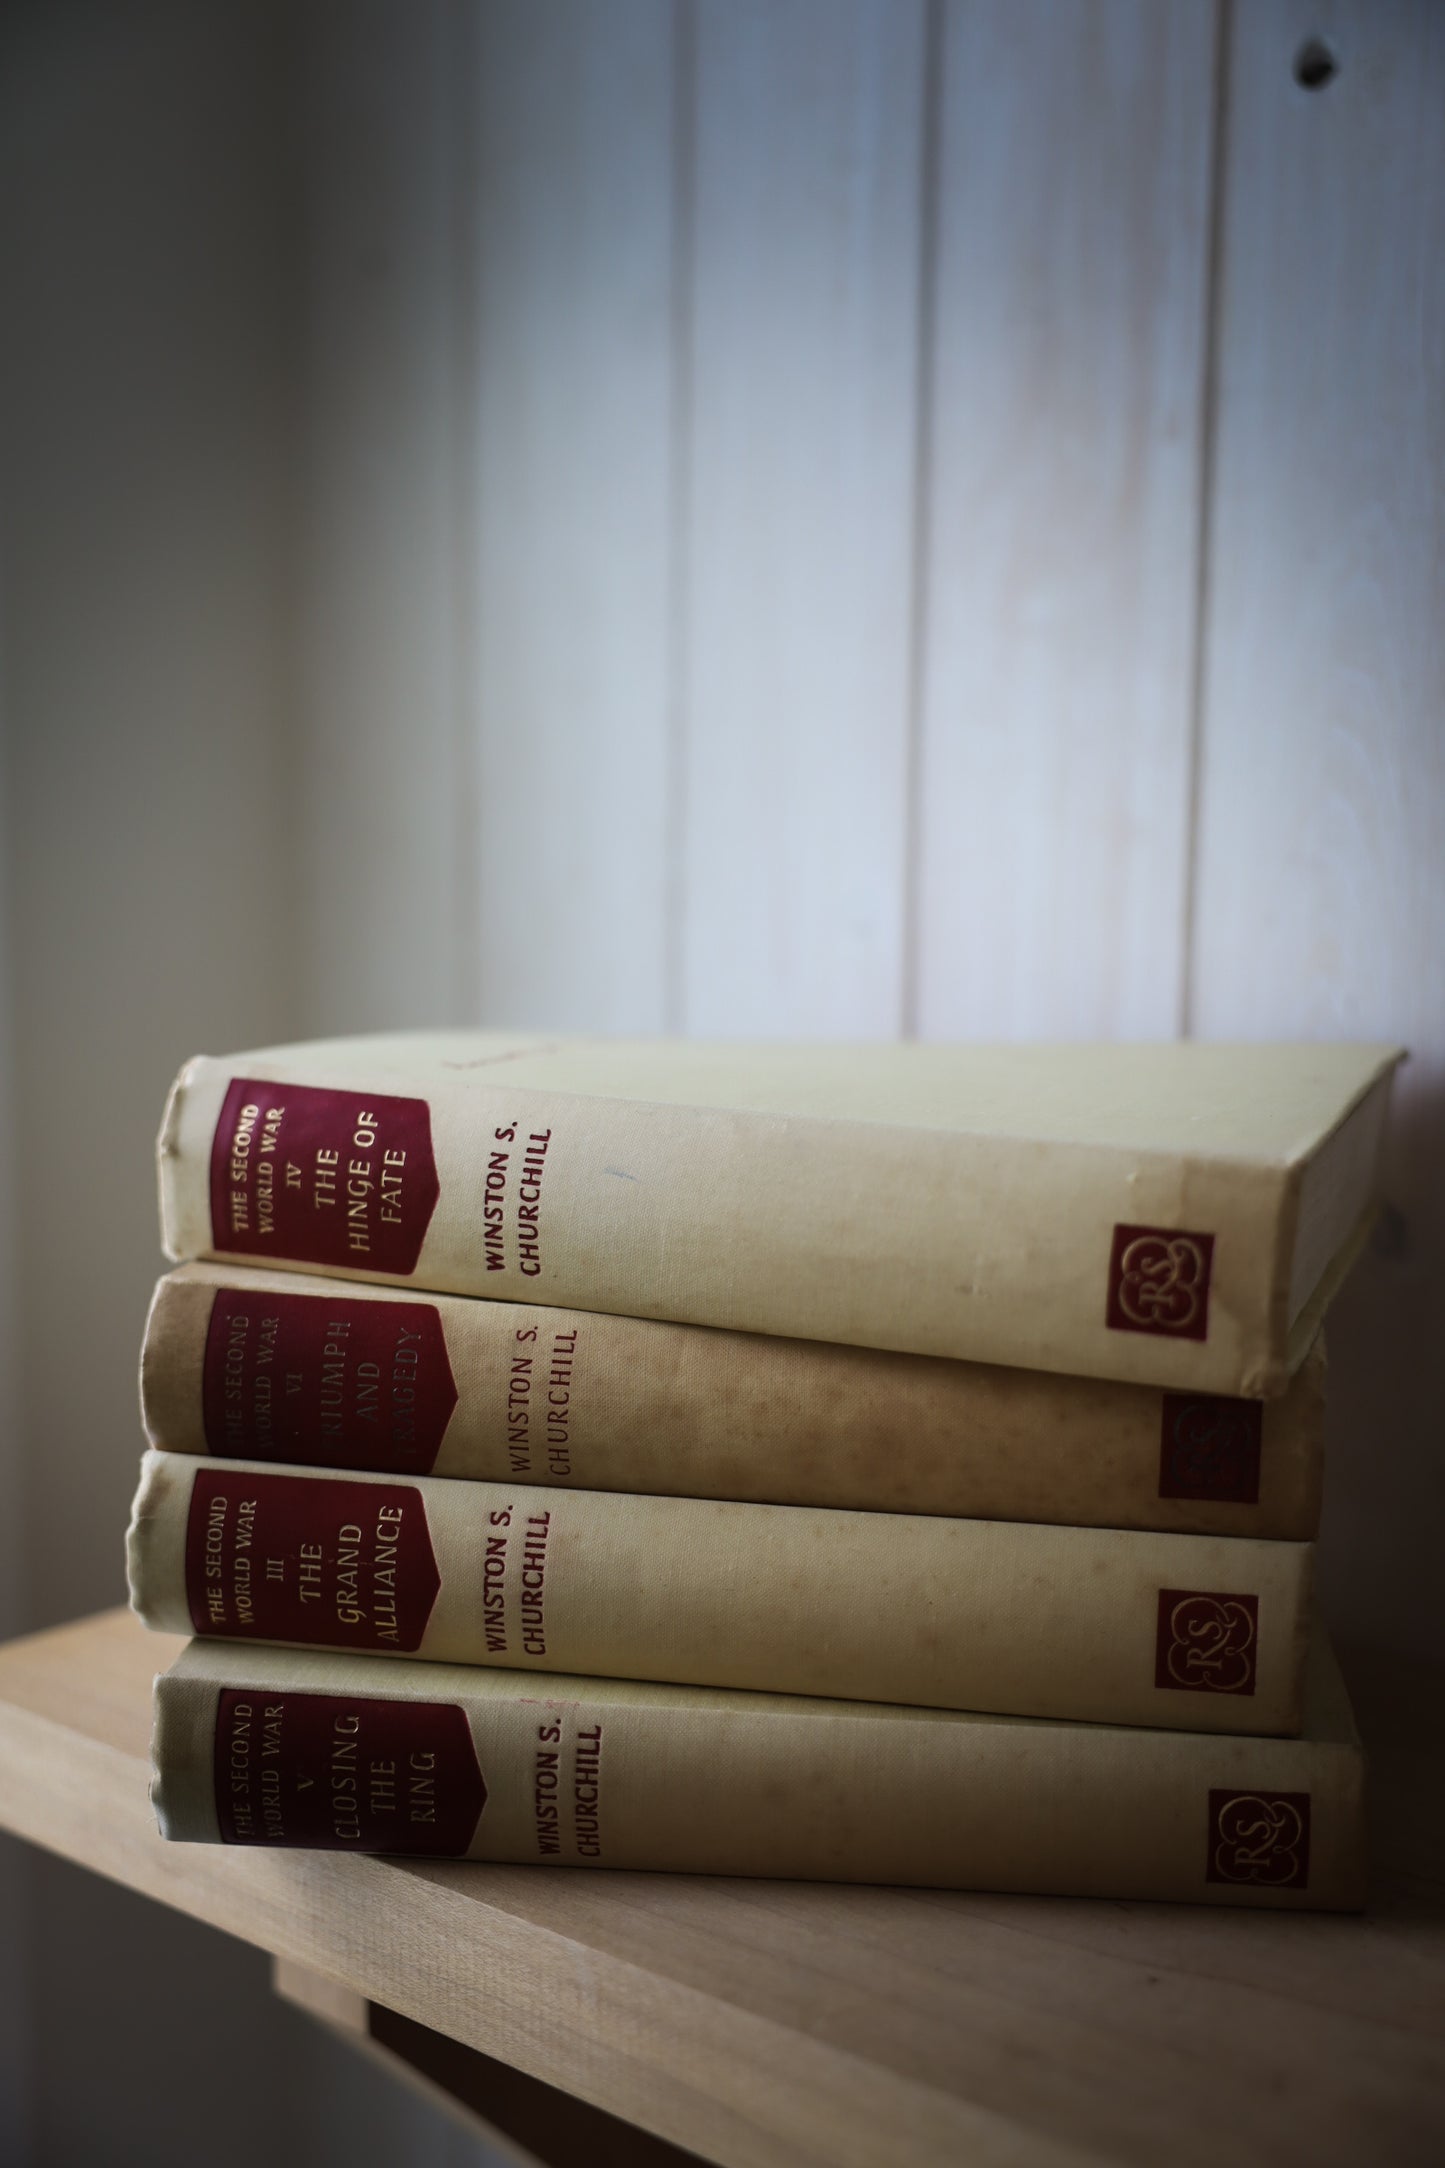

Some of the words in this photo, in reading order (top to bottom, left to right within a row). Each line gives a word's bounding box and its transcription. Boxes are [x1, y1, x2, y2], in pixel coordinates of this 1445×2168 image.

[232, 1103, 260, 1182] SECOND
[261, 1105, 286, 1153] WAR
[353, 1110, 379, 1148] OF
[494, 1121, 518, 1143] S.
[256, 1160, 275, 1235] WORLD
[285, 1161, 302, 1189] IV
[315, 1148, 340, 1209] THE
[347, 1160, 372, 1252] HINGE
[380, 1148, 407, 1224] FATE
[517, 1128, 552, 1277] CHURCHILL
[231, 1190, 249, 1234] THE
[483, 1151, 510, 1272] WINSTON
[224, 1315, 250, 1400] SECOND
[256, 1316, 280, 1365] WAR
[515, 1325, 538, 1342] S.
[286, 1373, 303, 1396] VI
[355, 1361, 381, 1423] AND
[507, 1357, 534, 1472] WINSTON
[546, 1329, 578, 1475] CHURCHILL
[206, 1495, 229, 1578] SECOND
[234, 1499, 258, 1550] WAR
[489, 1504, 514, 1528] S.
[233, 1557, 254, 1626] WORLD
[265, 1558, 285, 1582] III
[299, 1542, 323, 1604] THE
[336, 1523, 362, 1624] GRAND
[372, 1505, 403, 1644] ALLIANCE
[483, 1537, 509, 1653] WINSTON
[520, 1511, 551, 1656] CHURCHILL
[210, 1587, 224, 1625] THE
[230, 1703, 254, 1794] SECOND
[261, 1701, 285, 1757] WAR
[538, 1717, 562, 1743] S.
[261, 1769, 285, 1840] WORLD
[297, 1775, 315, 1792] V
[331, 1714, 362, 1841] CLOSING
[371, 1759, 396, 1814] THE
[409, 1751, 436, 1824] RING
[535, 1752, 561, 1855] WINSTON
[574, 1725, 602, 1858] CHURCHILL
[232, 1801, 256, 1840] THE
